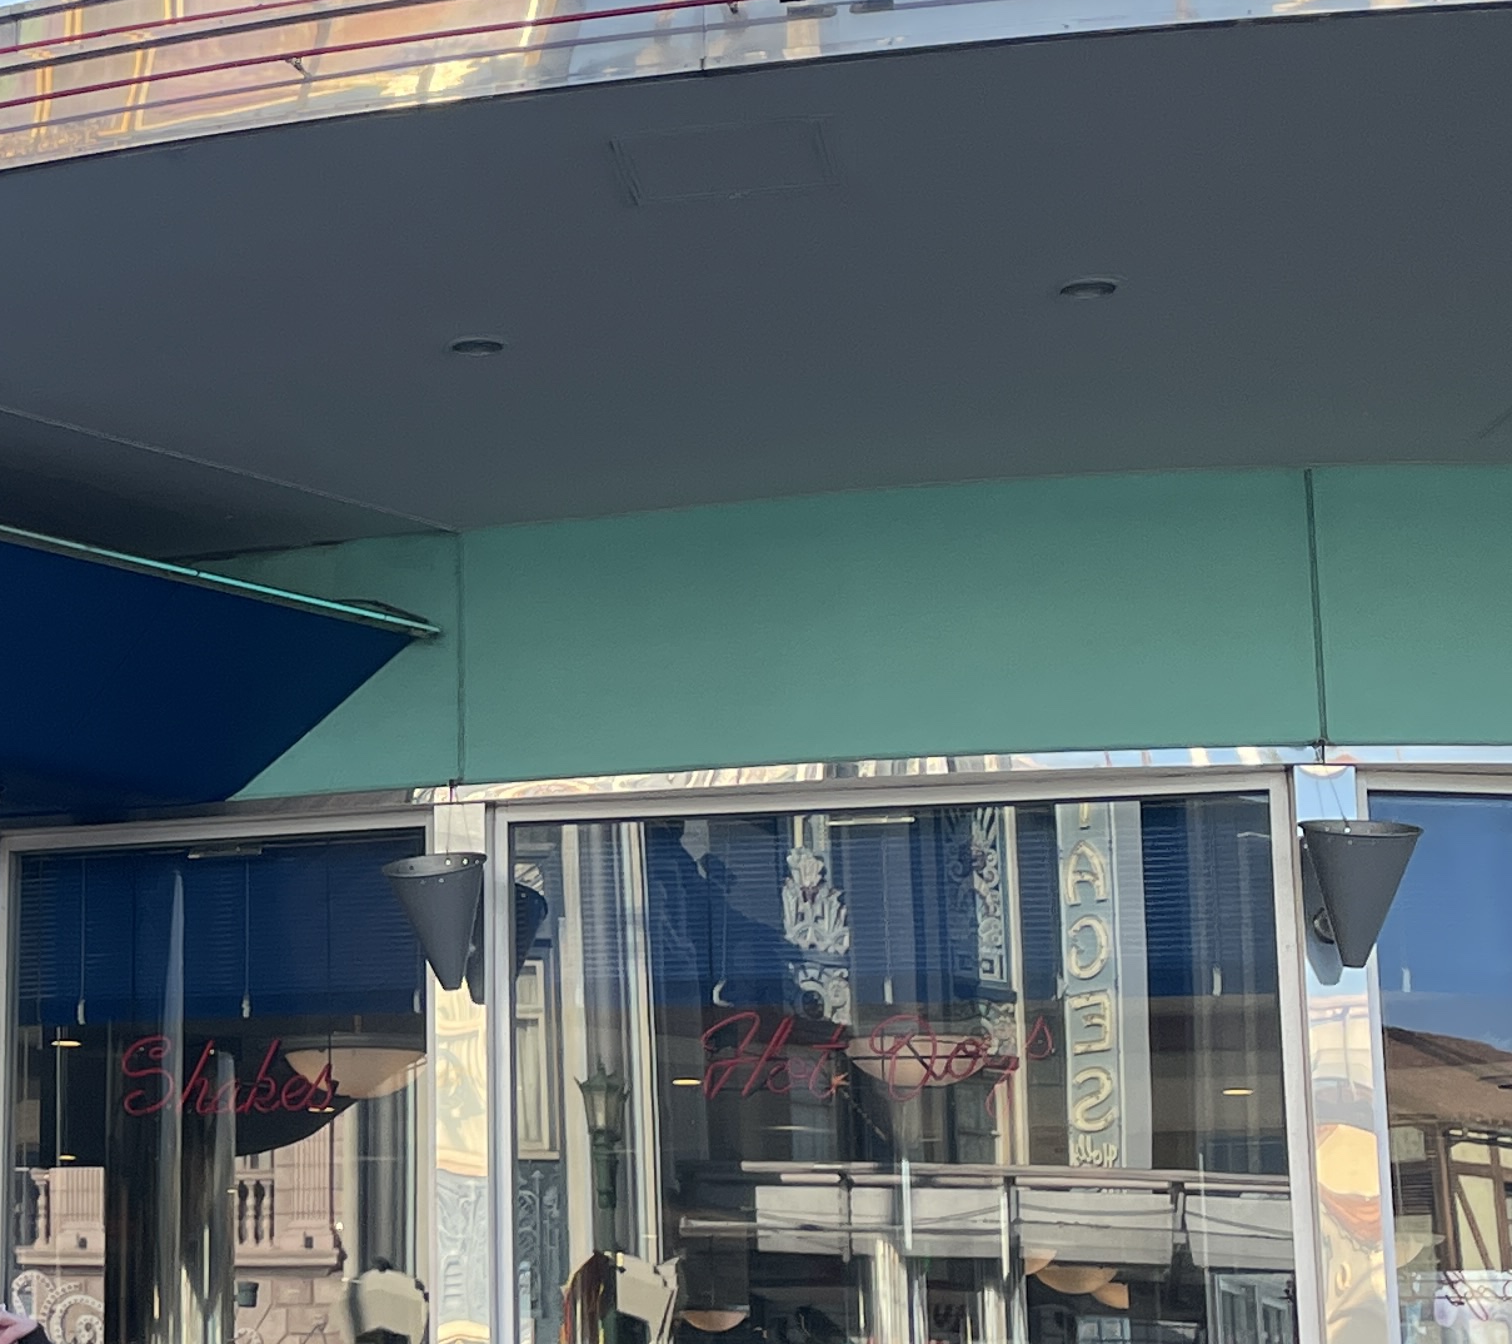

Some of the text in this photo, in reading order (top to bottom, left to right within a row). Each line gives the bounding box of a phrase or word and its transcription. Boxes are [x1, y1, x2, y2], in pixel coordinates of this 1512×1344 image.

[121, 1033, 334, 1118] Shakes
[701, 1010, 1054, 1119] Hot Dogs
